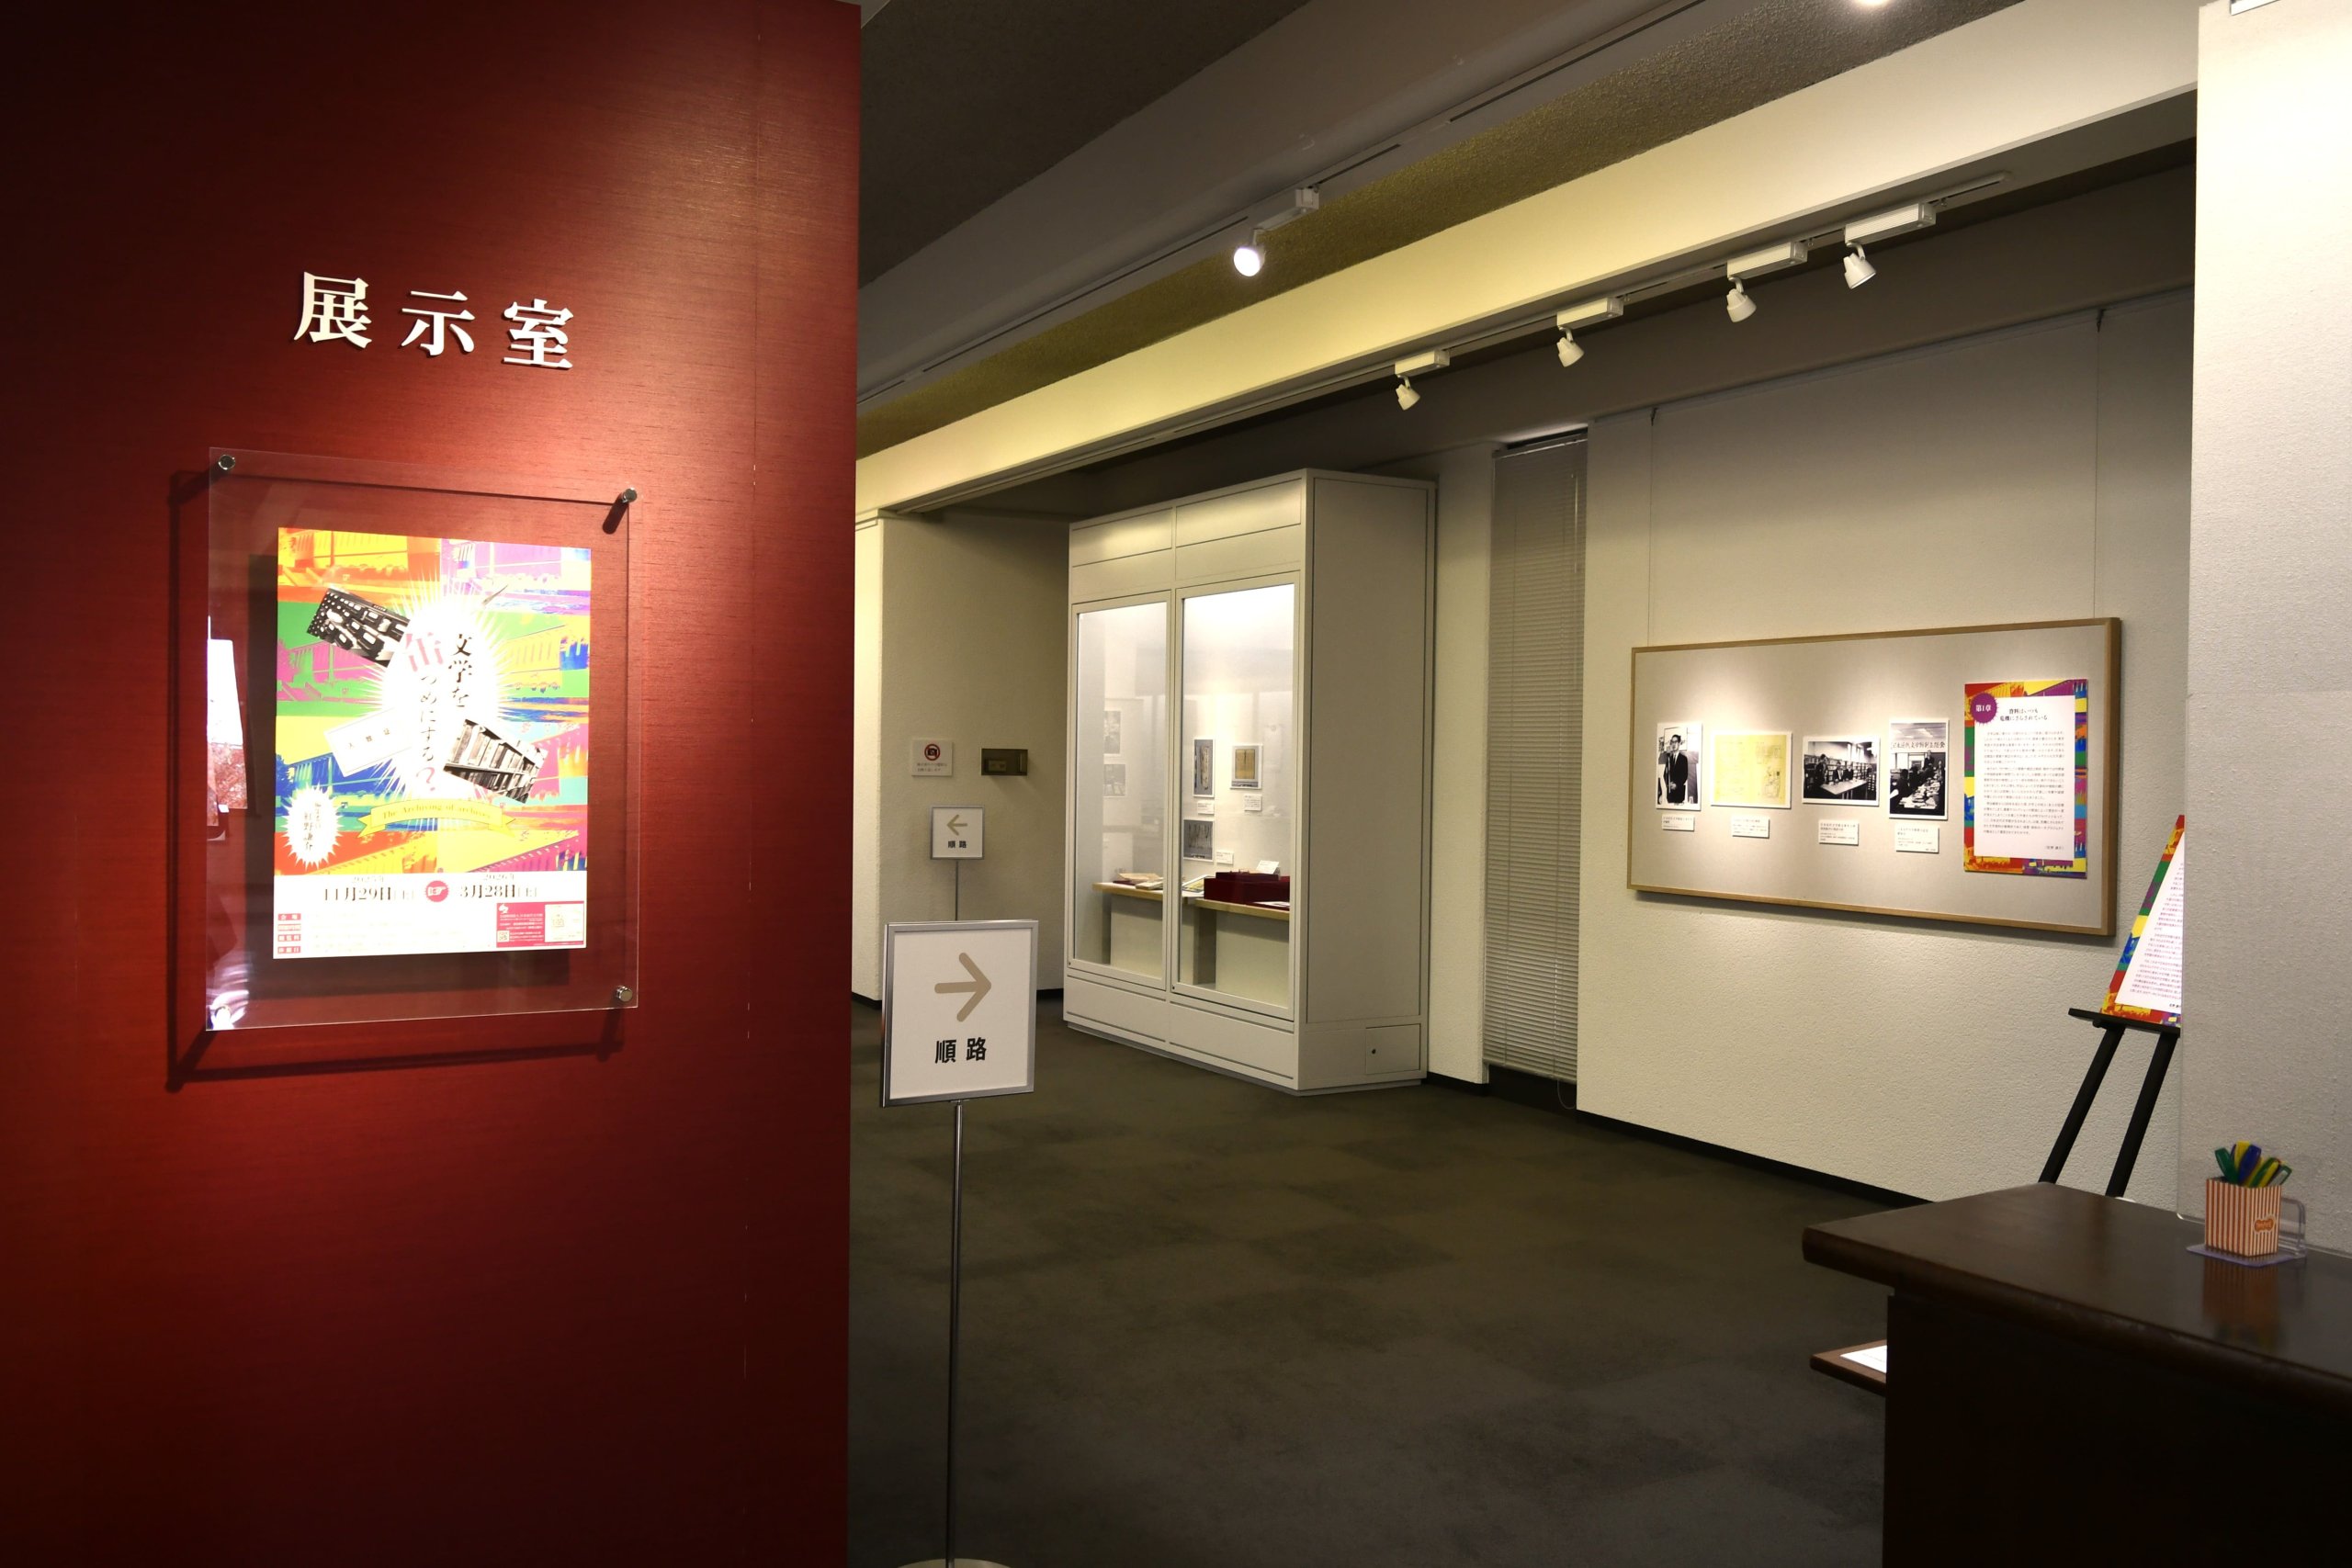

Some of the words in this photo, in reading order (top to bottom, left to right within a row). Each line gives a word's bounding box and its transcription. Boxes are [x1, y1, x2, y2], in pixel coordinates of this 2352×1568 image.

[293, 271, 573, 368] 展示室
[447, 632, 473, 708] 文学を
[1975, 704, 1992, 712] 第1章
[947, 840, 967, 849] 順路
[934, 1036, 988, 1065] 順路
